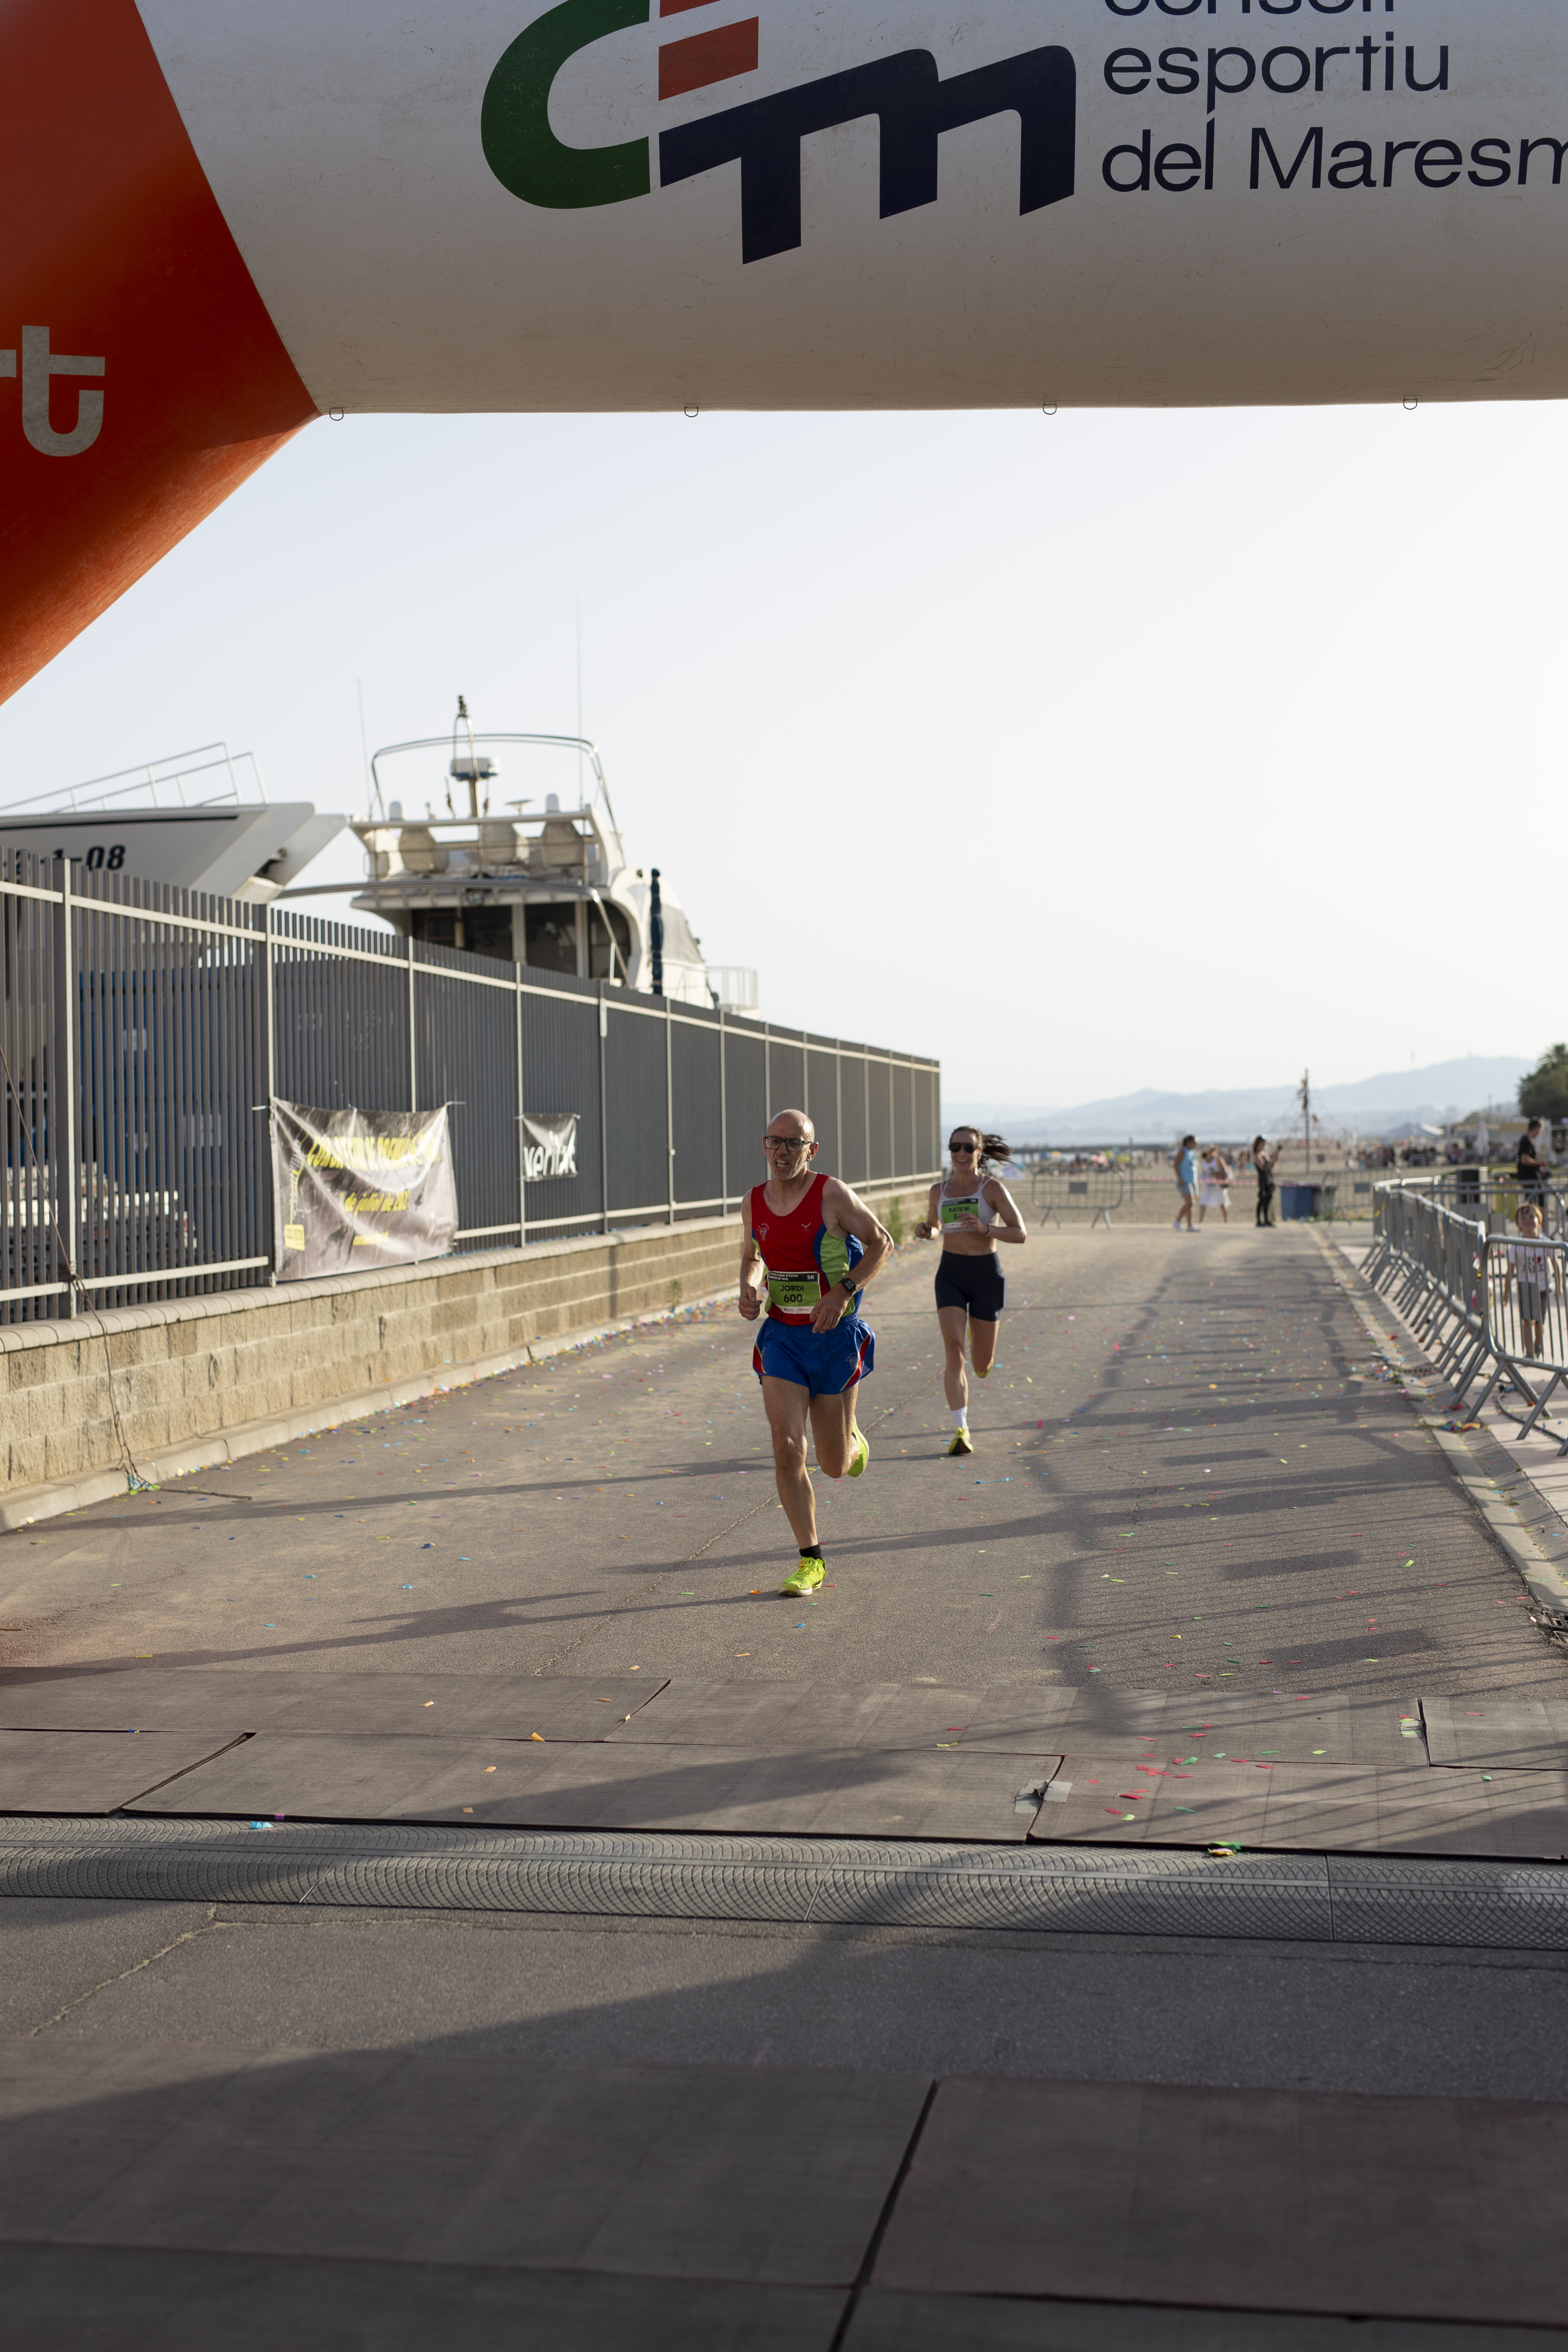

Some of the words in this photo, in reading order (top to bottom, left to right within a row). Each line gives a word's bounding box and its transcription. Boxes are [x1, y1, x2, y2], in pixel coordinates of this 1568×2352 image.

[1103, 31, 1449, 115] esportiu
[1101, 116, 1216, 192] del
[0, 325, 106, 457] t
[784, 1294, 803, 1303] 600
